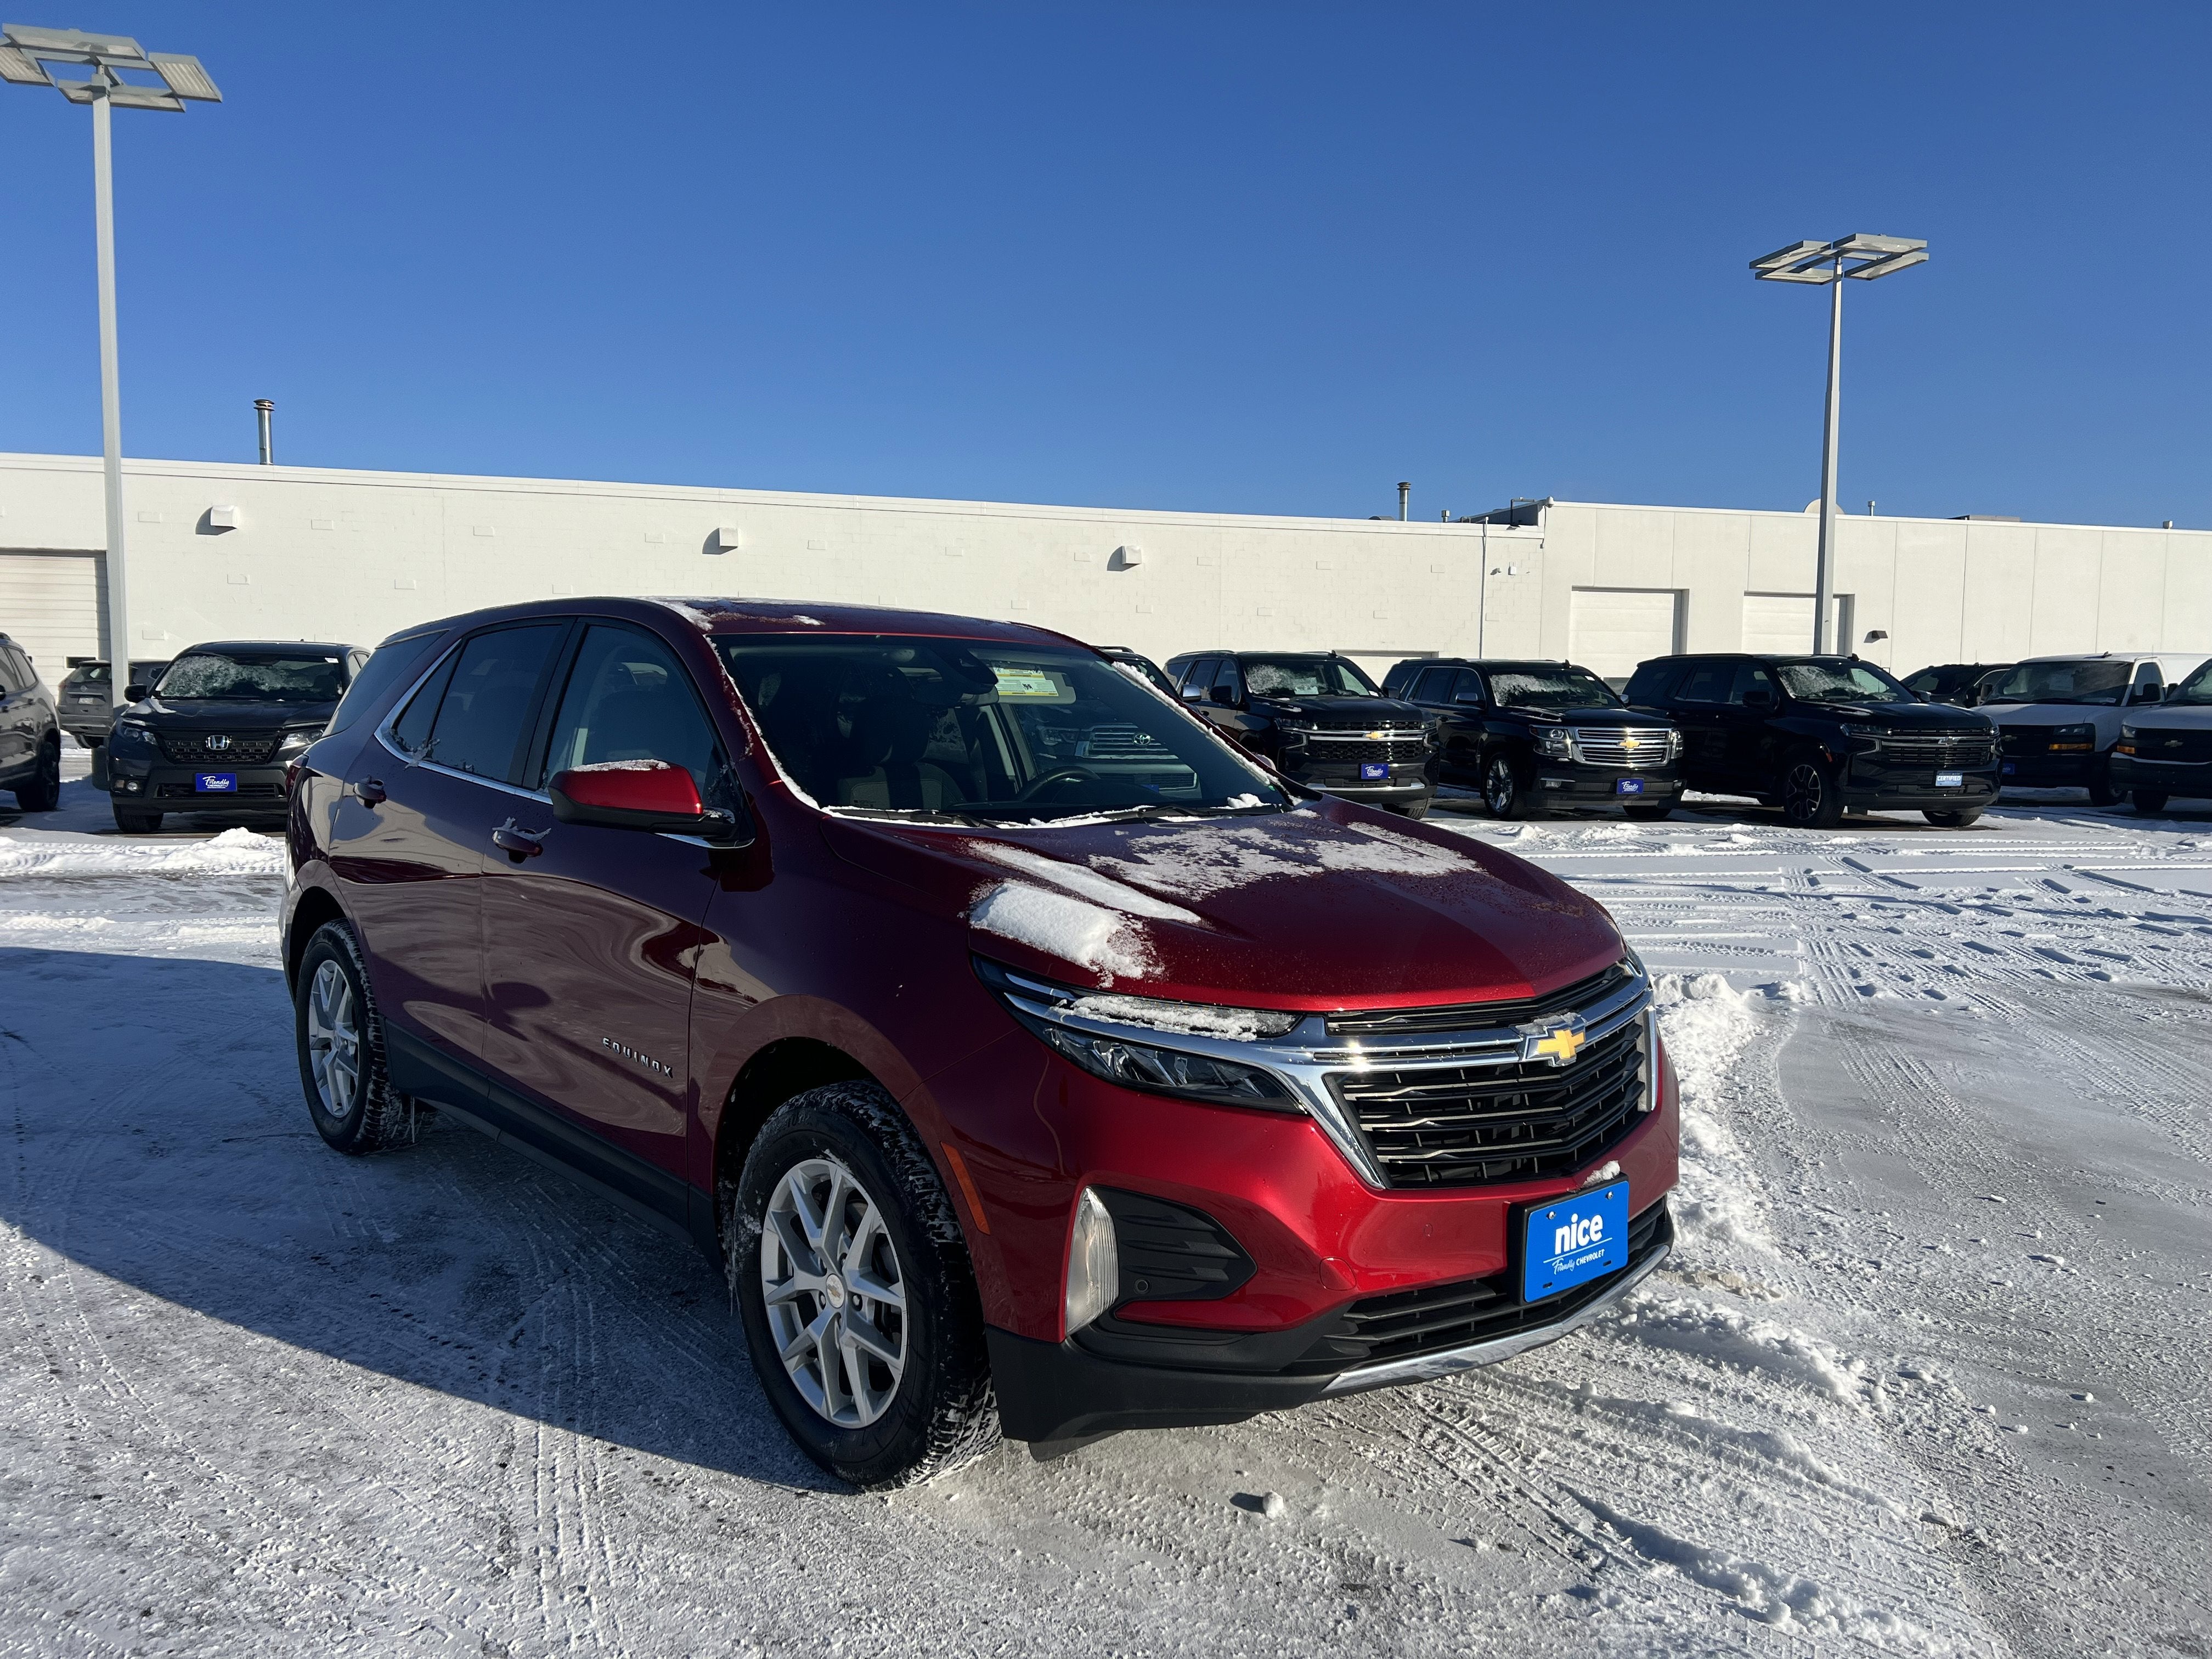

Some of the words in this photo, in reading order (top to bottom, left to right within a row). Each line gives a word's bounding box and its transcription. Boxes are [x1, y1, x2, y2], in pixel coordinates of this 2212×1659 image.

[202, 776, 229, 787] Friendly
[602, 1037, 673, 1079] EQUINOX
[1554, 1213, 1603, 1255] nice
[1551, 1257, 1575, 1275] Friendly
[1576, 1249, 1605, 1266] CHEVROLET
